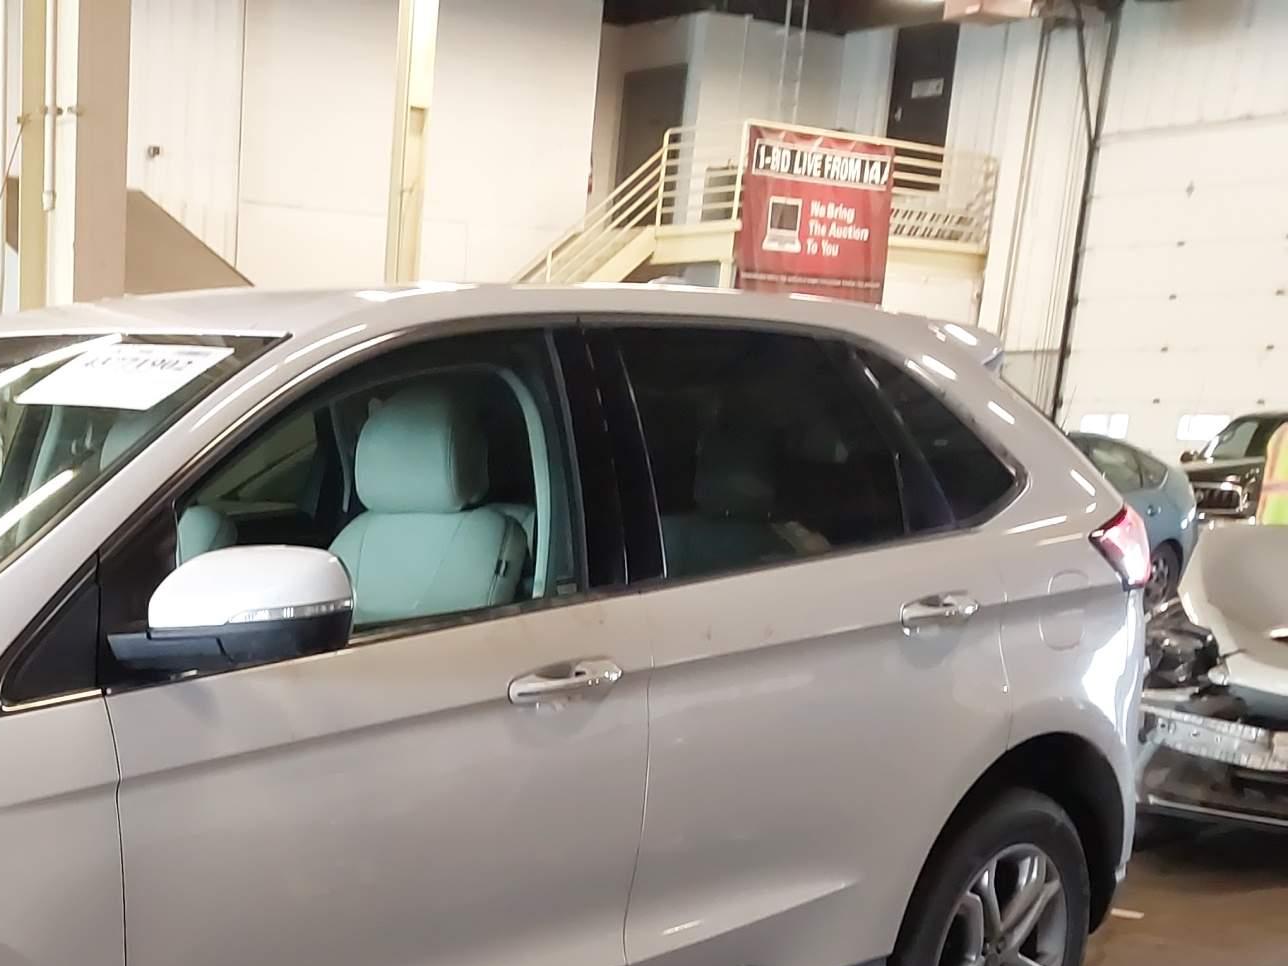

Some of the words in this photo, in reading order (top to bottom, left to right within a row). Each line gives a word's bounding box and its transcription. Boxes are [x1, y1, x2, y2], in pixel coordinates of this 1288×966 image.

[793, 149, 822, 178] LIVE
[824, 155, 861, 183] FROM
[810, 199, 826, 217] We
[827, 201, 856, 224] Bring
[808, 219, 827, 237] The
[828, 221, 870, 241] Auction
[806, 238, 818, 255] To
[821, 239, 840, 257] You
